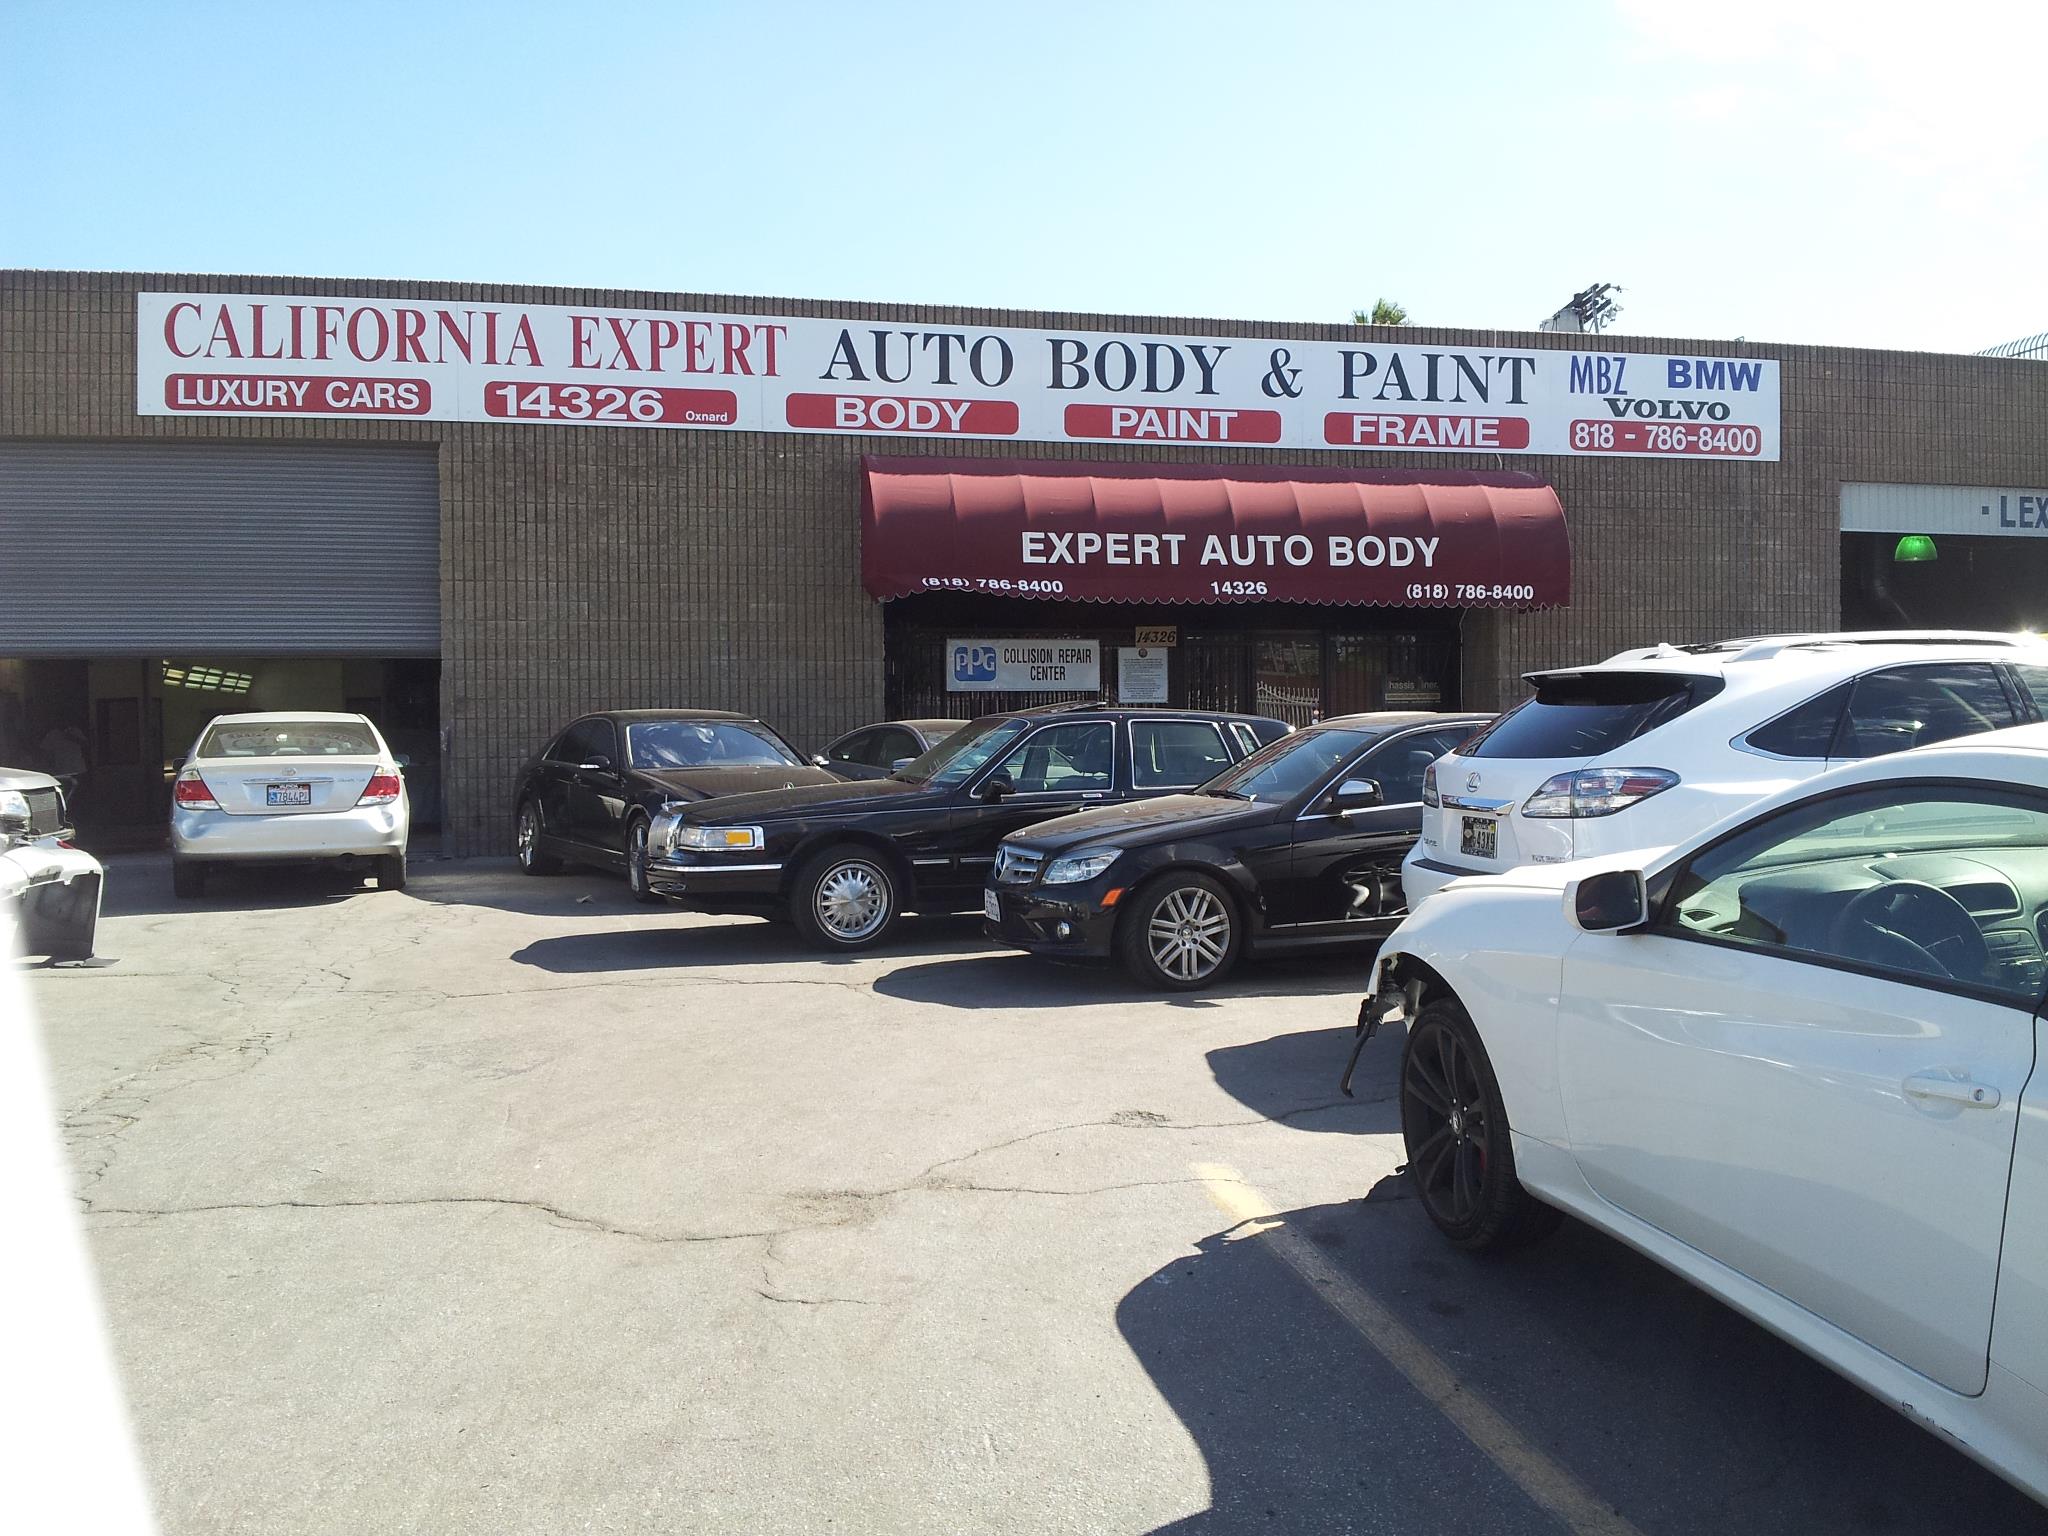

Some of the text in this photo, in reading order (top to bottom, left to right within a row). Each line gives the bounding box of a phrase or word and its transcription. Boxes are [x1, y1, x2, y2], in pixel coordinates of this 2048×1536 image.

[163, 303, 1536, 405] CALIFORNIA EXPERT AUTO BODY & PAINT
[1569, 355, 1763, 396] MBZ BMW
[175, 377, 421, 410] LUXURY CARS
[495, 384, 729, 423] 14326 Oxnard
[835, 396, 971, 432] BODY
[1111, 407, 1239, 440] PAINT
[1603, 398, 1731, 421] VOLVO
[1352, 415, 1500, 447] FRAME
[1575, 422, 1615, 449] 818
[1645, 425, 1757, 452] 786-8400
[2001, 496, 2048, 529] LEX
[1021, 531, 1441, 569] EXPERT AUTO BODY
[922, 577, 1063, 593] (818) 786-8400
[1210, 581, 1268, 596] 14326
[1406, 584, 1534, 599] (818) 786-8400
[1137, 630, 1176, 643] 14326
[955, 647, 996, 675] PPG
[1003, 648, 1092, 664] COLLISION REPAIR
[1030, 665, 1066, 681] CENTER
